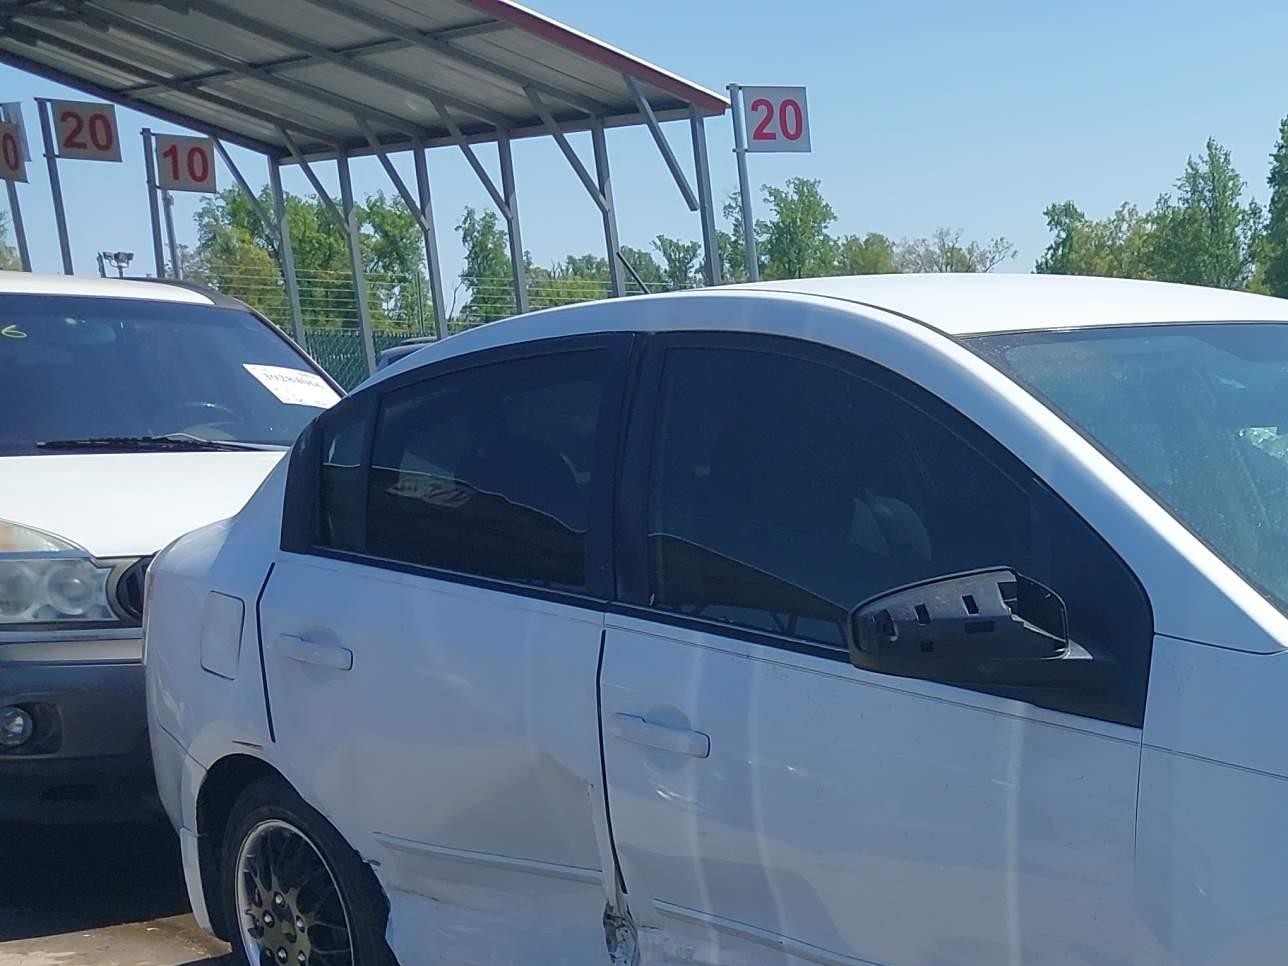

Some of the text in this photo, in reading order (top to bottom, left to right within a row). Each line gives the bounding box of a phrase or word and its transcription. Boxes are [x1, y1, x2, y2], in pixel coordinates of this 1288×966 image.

[60, 110, 114, 151] 20
[751, 98, 803, 141] 20
[163, 144, 209, 183] 10
